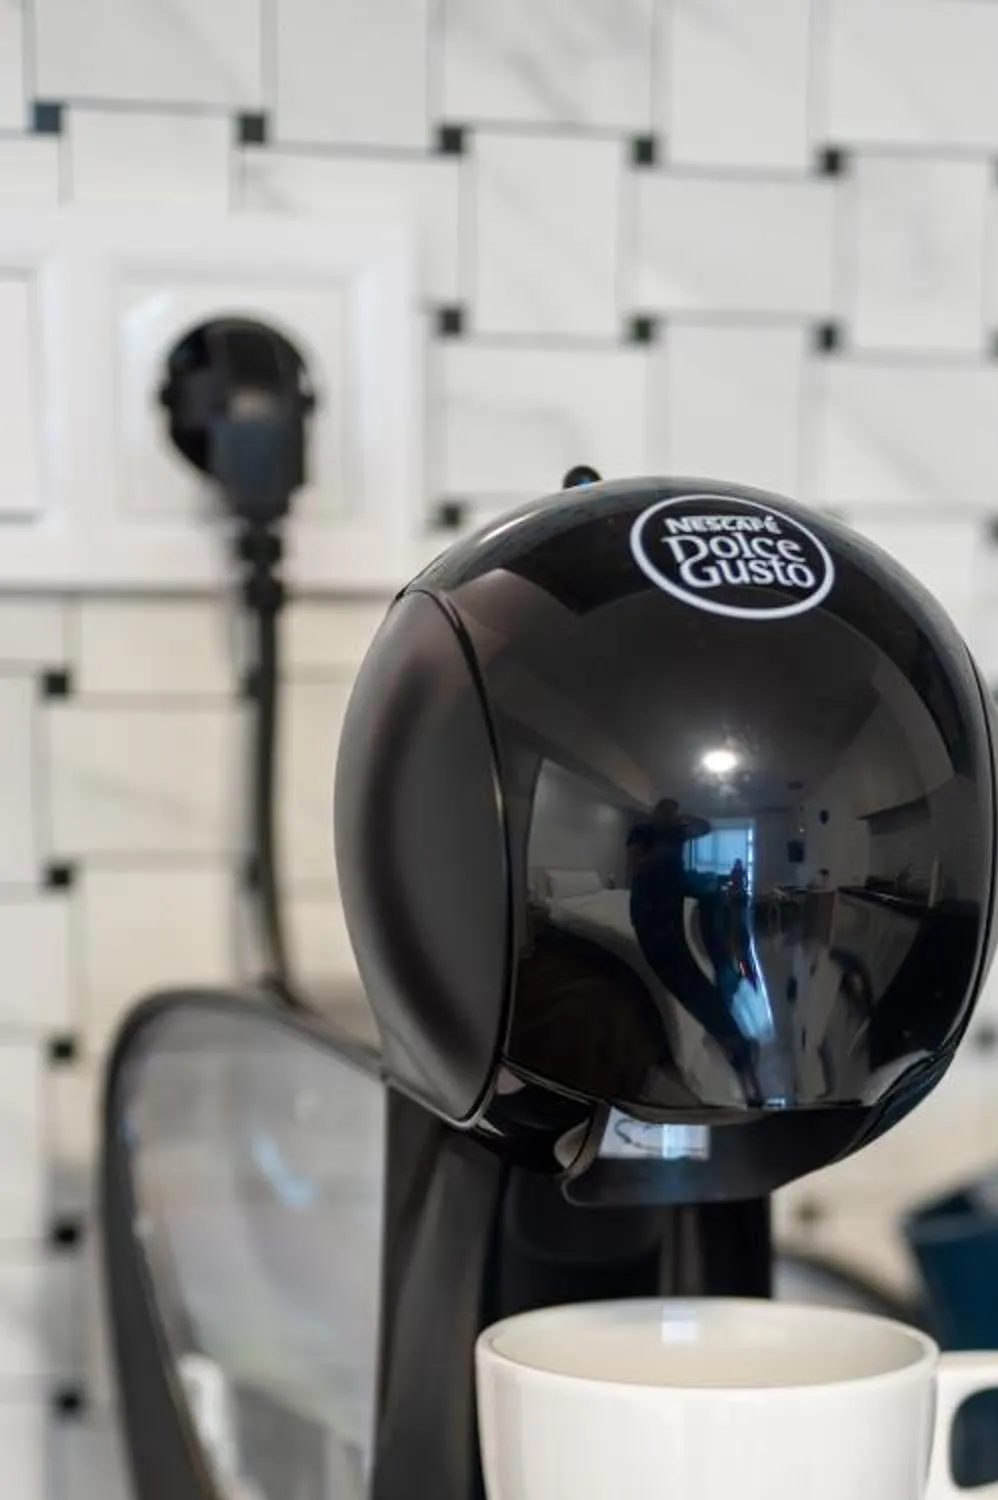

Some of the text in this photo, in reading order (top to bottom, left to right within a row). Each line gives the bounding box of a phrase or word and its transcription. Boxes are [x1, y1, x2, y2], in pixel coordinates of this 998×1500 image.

[664, 514, 782, 535] NESCAFÉ
[661, 531, 806, 563] Dolce
[679, 556, 816, 588] Gusto
